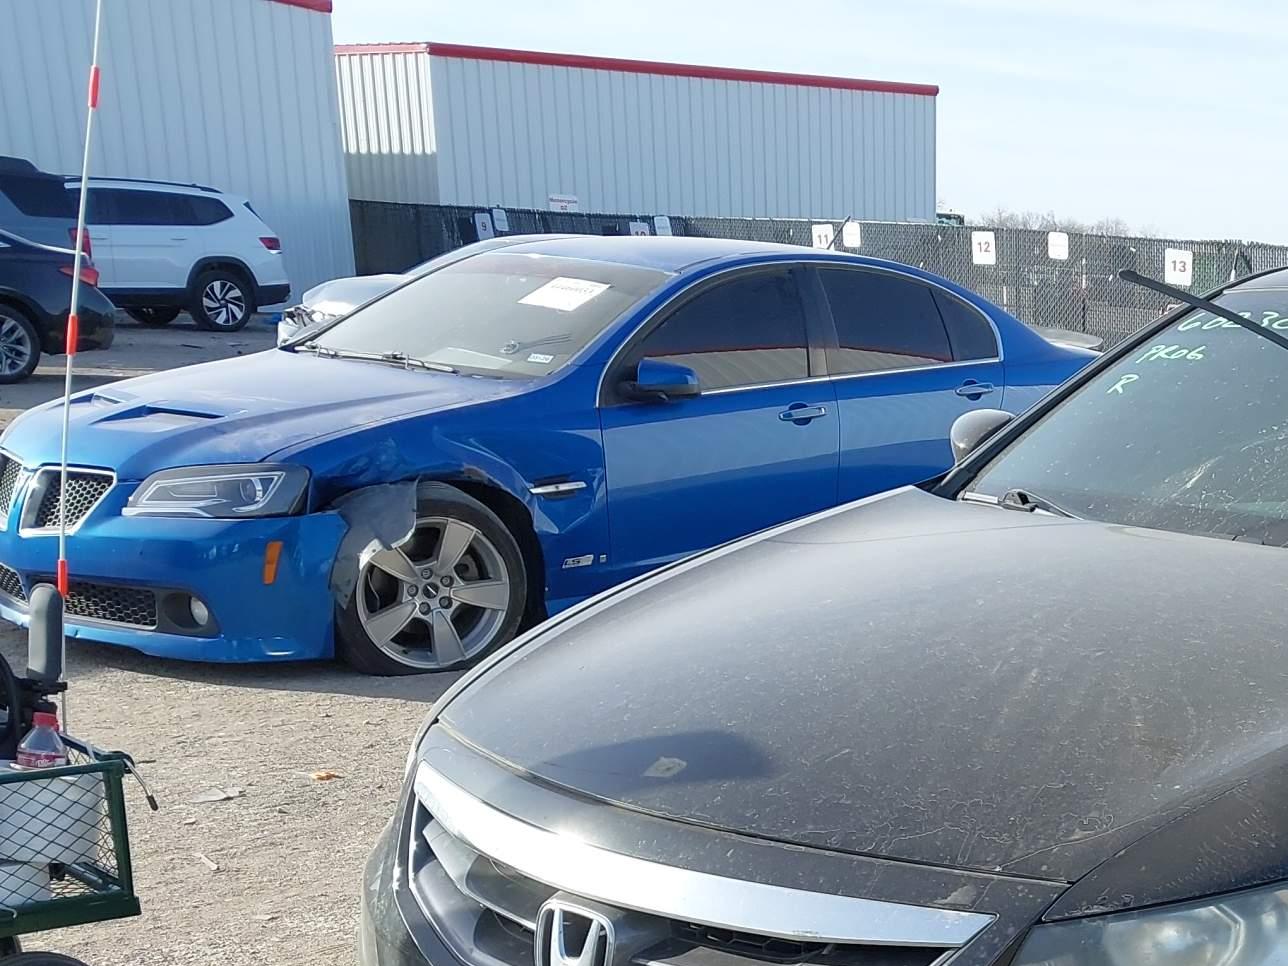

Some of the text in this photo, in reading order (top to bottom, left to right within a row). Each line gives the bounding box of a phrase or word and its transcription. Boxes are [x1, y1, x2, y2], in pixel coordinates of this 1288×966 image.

[817, 233, 830, 245] 11
[977, 241, 991, 253] 12
[1171, 259, 1187, 273] 13
[1107, 373, 1140, 395] R
